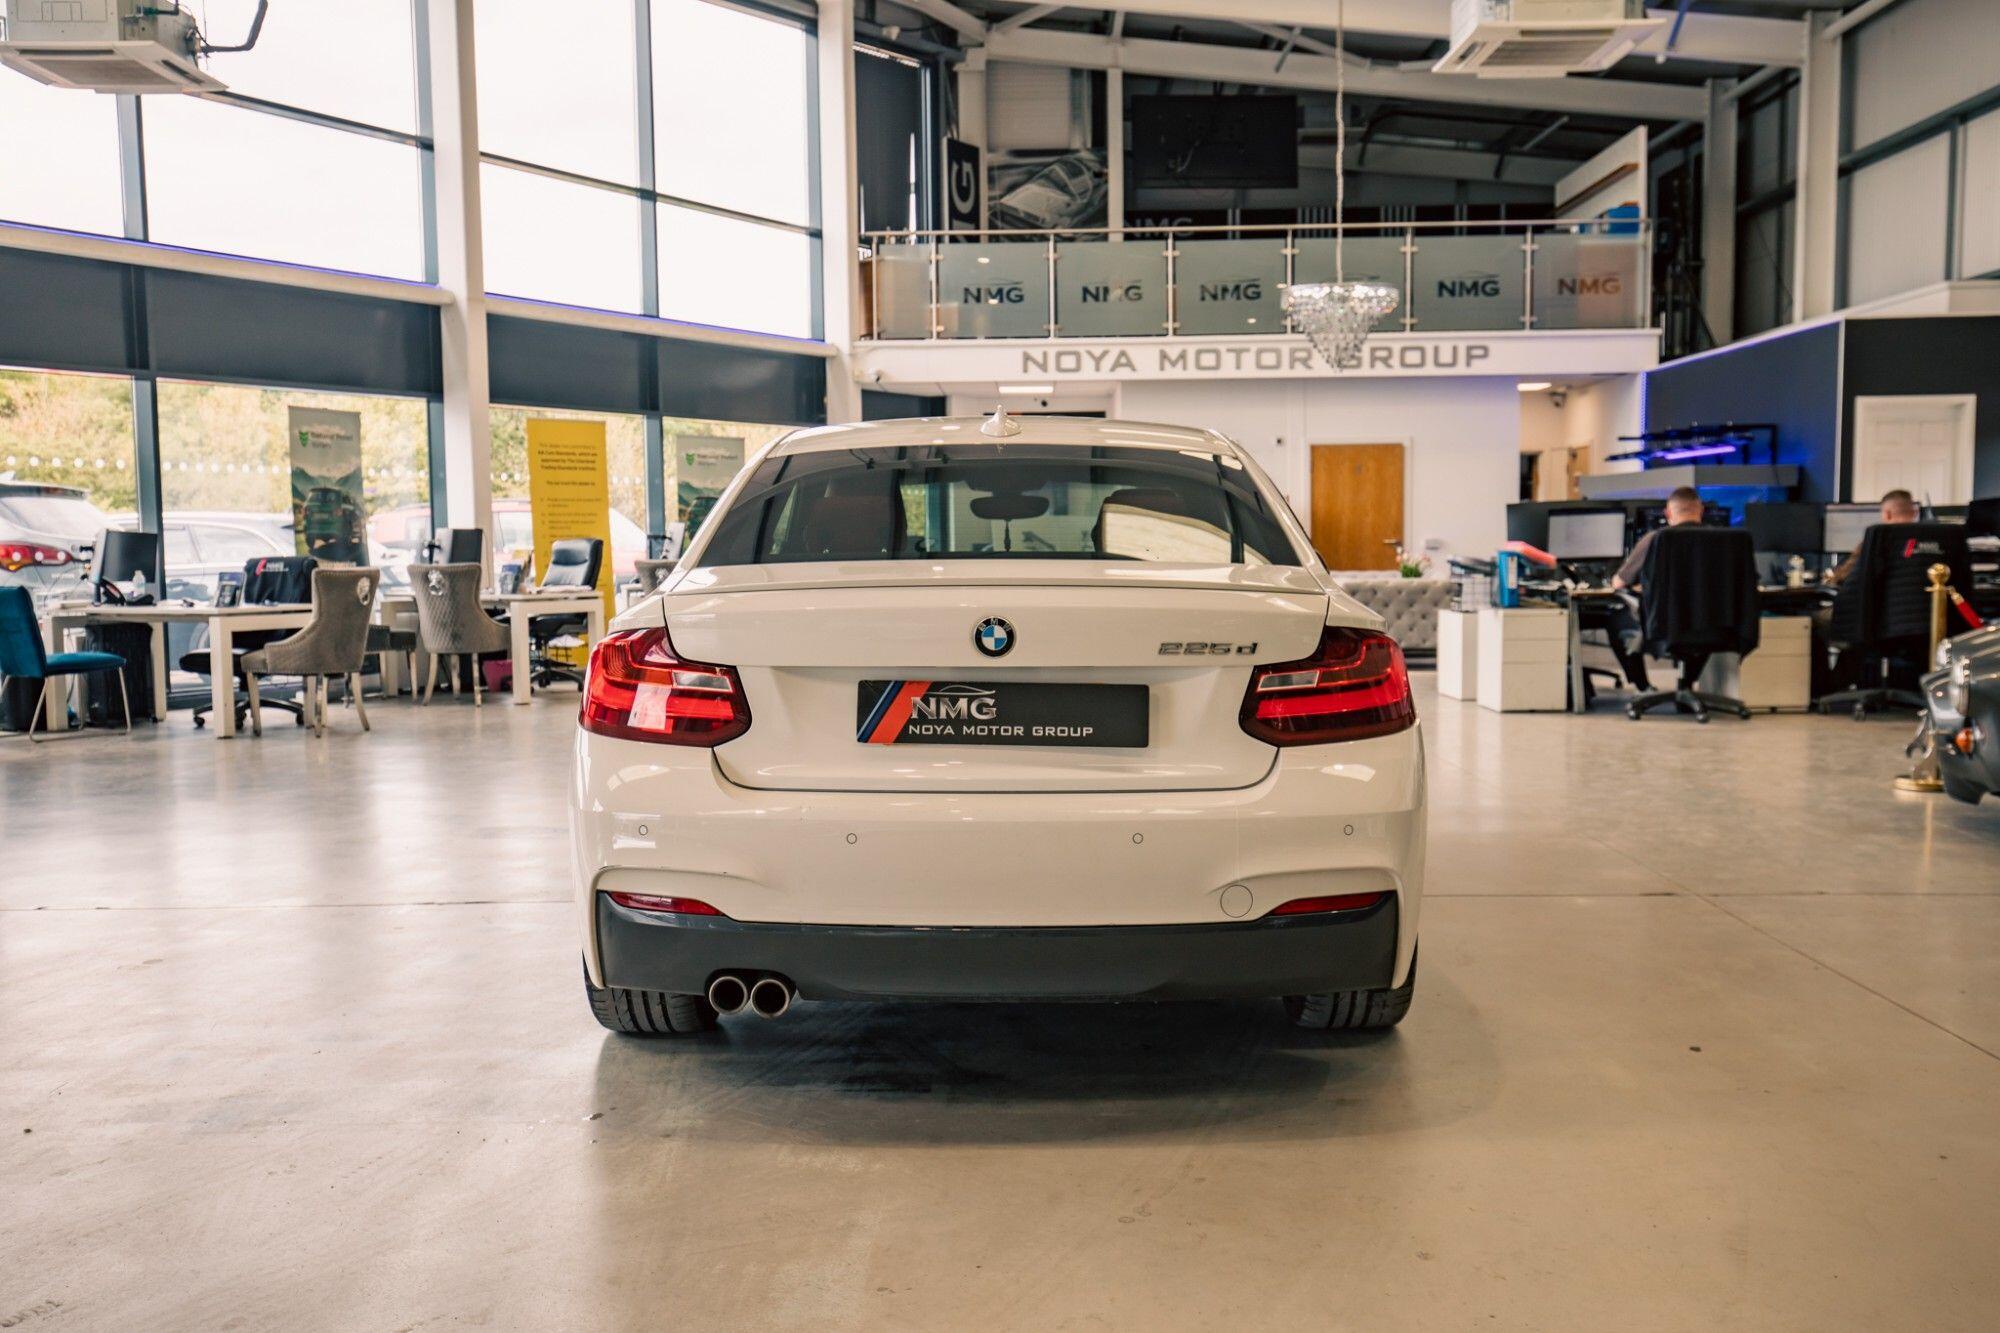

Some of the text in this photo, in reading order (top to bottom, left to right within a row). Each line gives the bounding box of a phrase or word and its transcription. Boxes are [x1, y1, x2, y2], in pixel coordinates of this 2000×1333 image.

[963, 286, 1025, 303] NMG
[1200, 282, 1262, 301] NMG
[1437, 278, 1500, 298] NMG
[1557, 277, 1621, 296] NMG
[1022, 344, 1490, 374] NOYA MOTOR GROUP
[1158, 642, 1258, 655] 225d
[910, 697, 997, 720] NMG
[909, 724, 1094, 737] NOYA MOTOR GROUP
